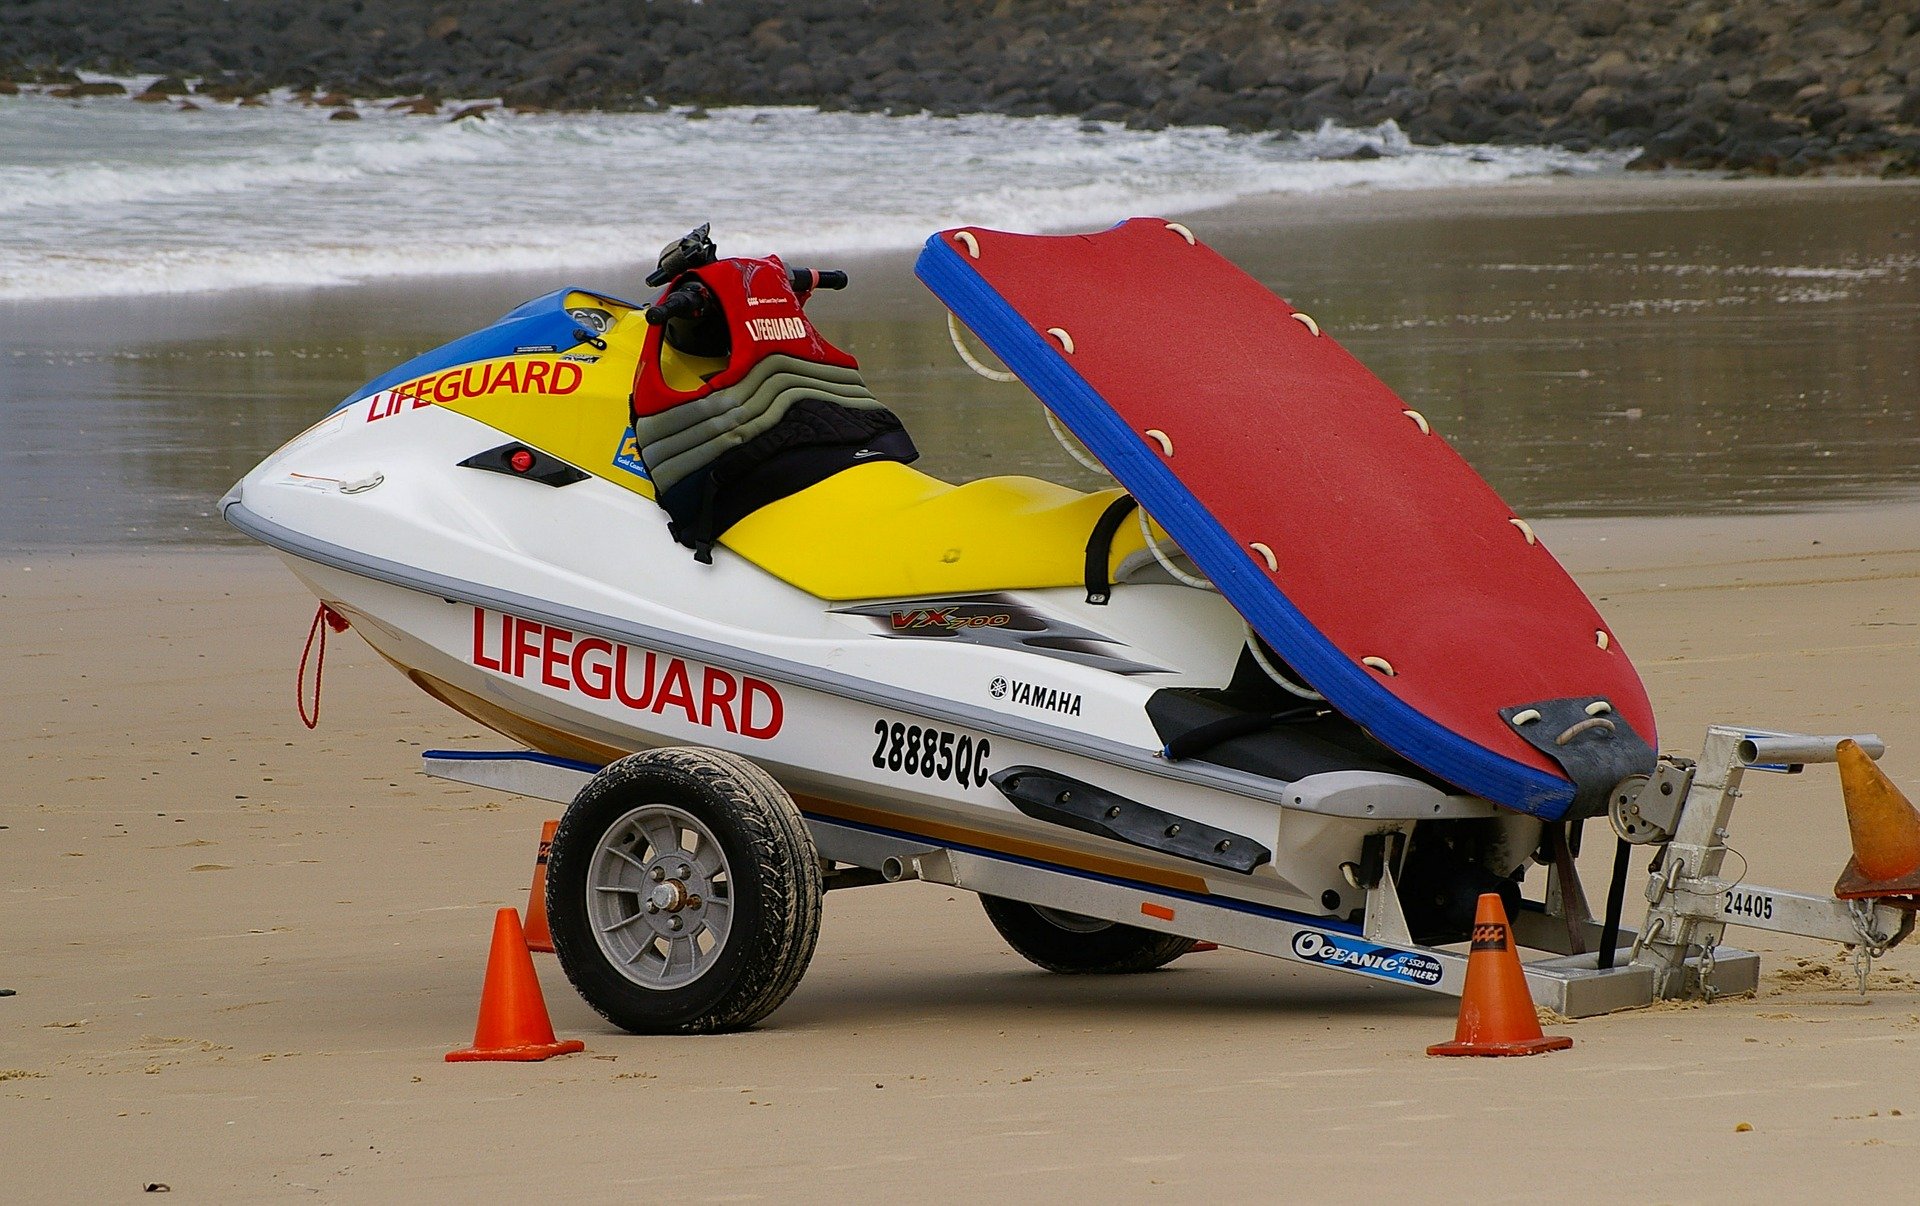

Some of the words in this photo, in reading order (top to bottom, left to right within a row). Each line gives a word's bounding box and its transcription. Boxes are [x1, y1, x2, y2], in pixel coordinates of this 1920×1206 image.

[745, 317, 806, 341] LIFEGUARD
[366, 361, 583, 423] LIFEGUARD
[472, 606, 785, 741] LIFEGUARD
[1011, 680, 1082, 717] YAMAHA
[872, 719, 991, 790] 28885QC
[1724, 891, 1773, 920] 24405
[1295, 932, 1398, 971] OCEANIC
[1408, 958, 1425, 968] 5529
[1398, 966, 1438, 981] TRAILERS
